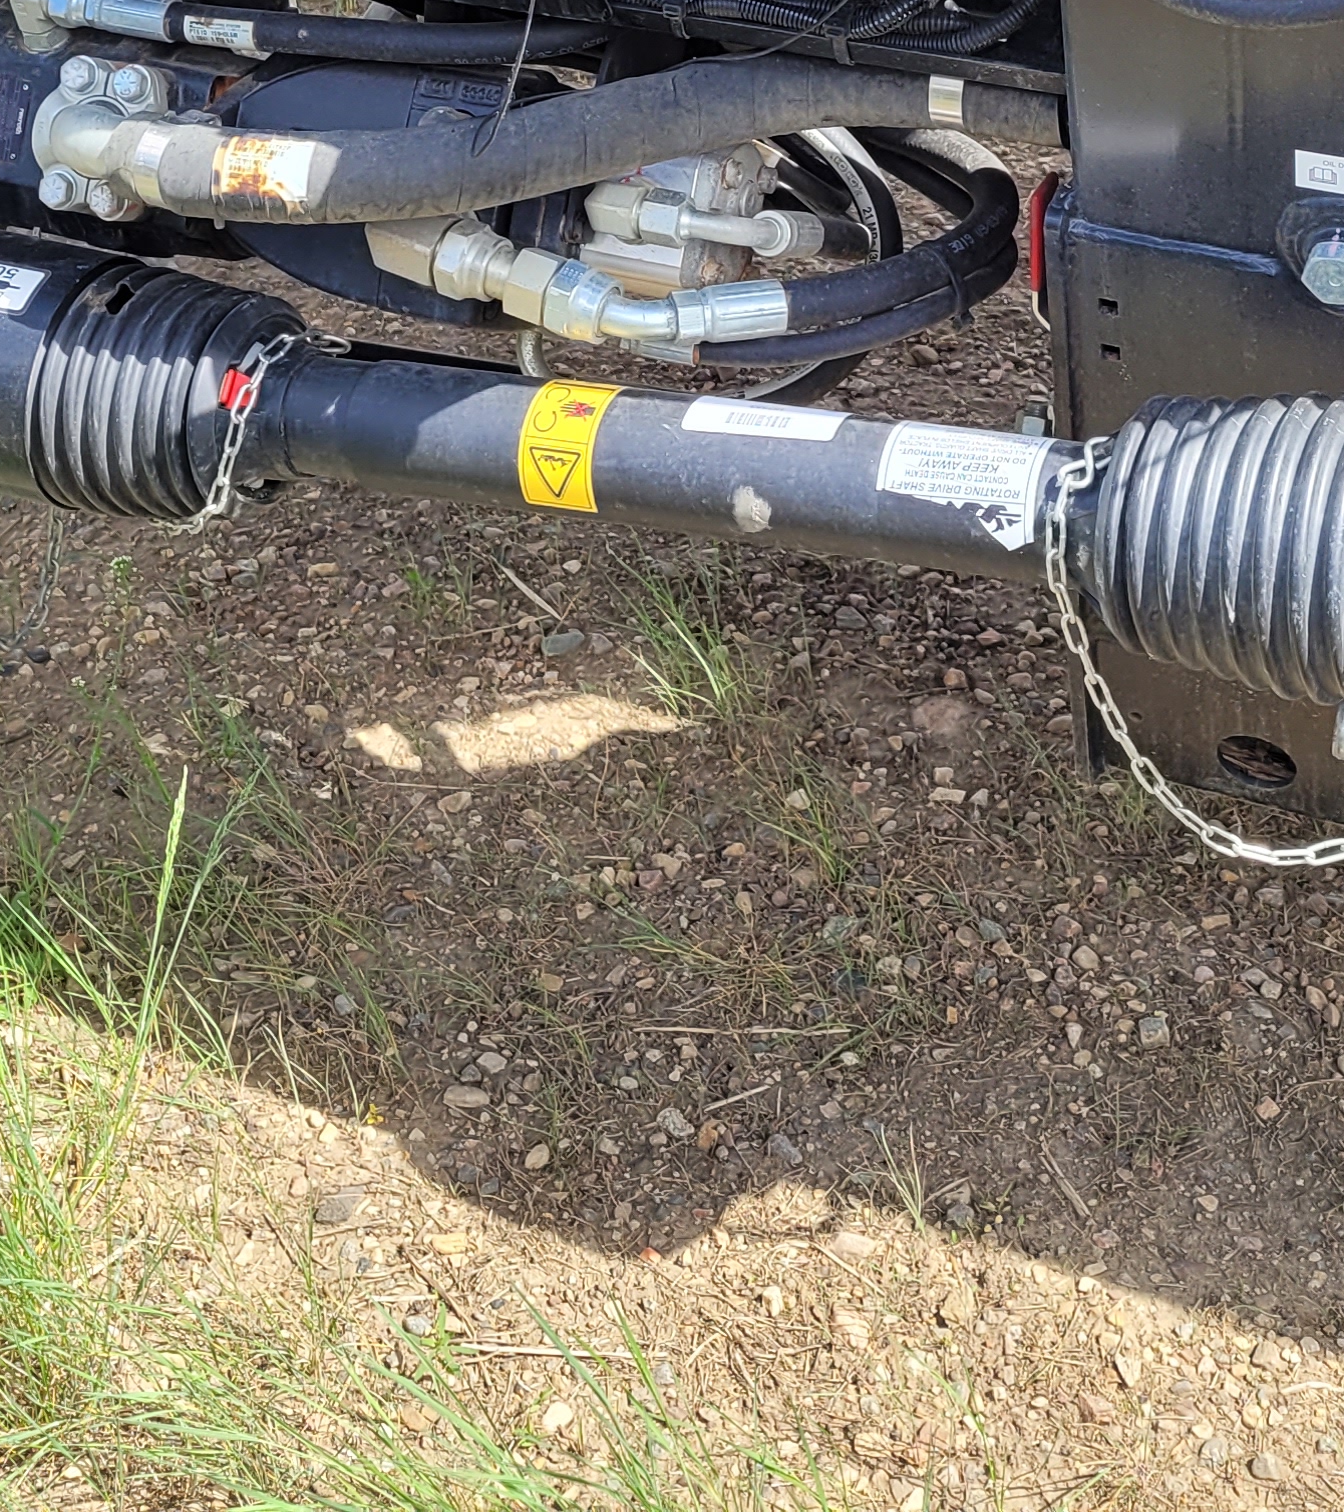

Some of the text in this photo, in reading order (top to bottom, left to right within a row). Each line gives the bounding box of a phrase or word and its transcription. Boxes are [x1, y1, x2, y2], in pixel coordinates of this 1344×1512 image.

[1322, 160, 1337, 168] OIL
[862, 206, 874, 220] 21
[946, 452, 989, 461] OPERATE
[991, 455, 1011, 463] NOT
[918, 458, 1000, 474] KEEP AWAY!
[905, 469, 1009, 484] CONTACT CAN CAUSE DEATH
[889, 480, 1021, 499] ROTATING DRIVE SHAFT
